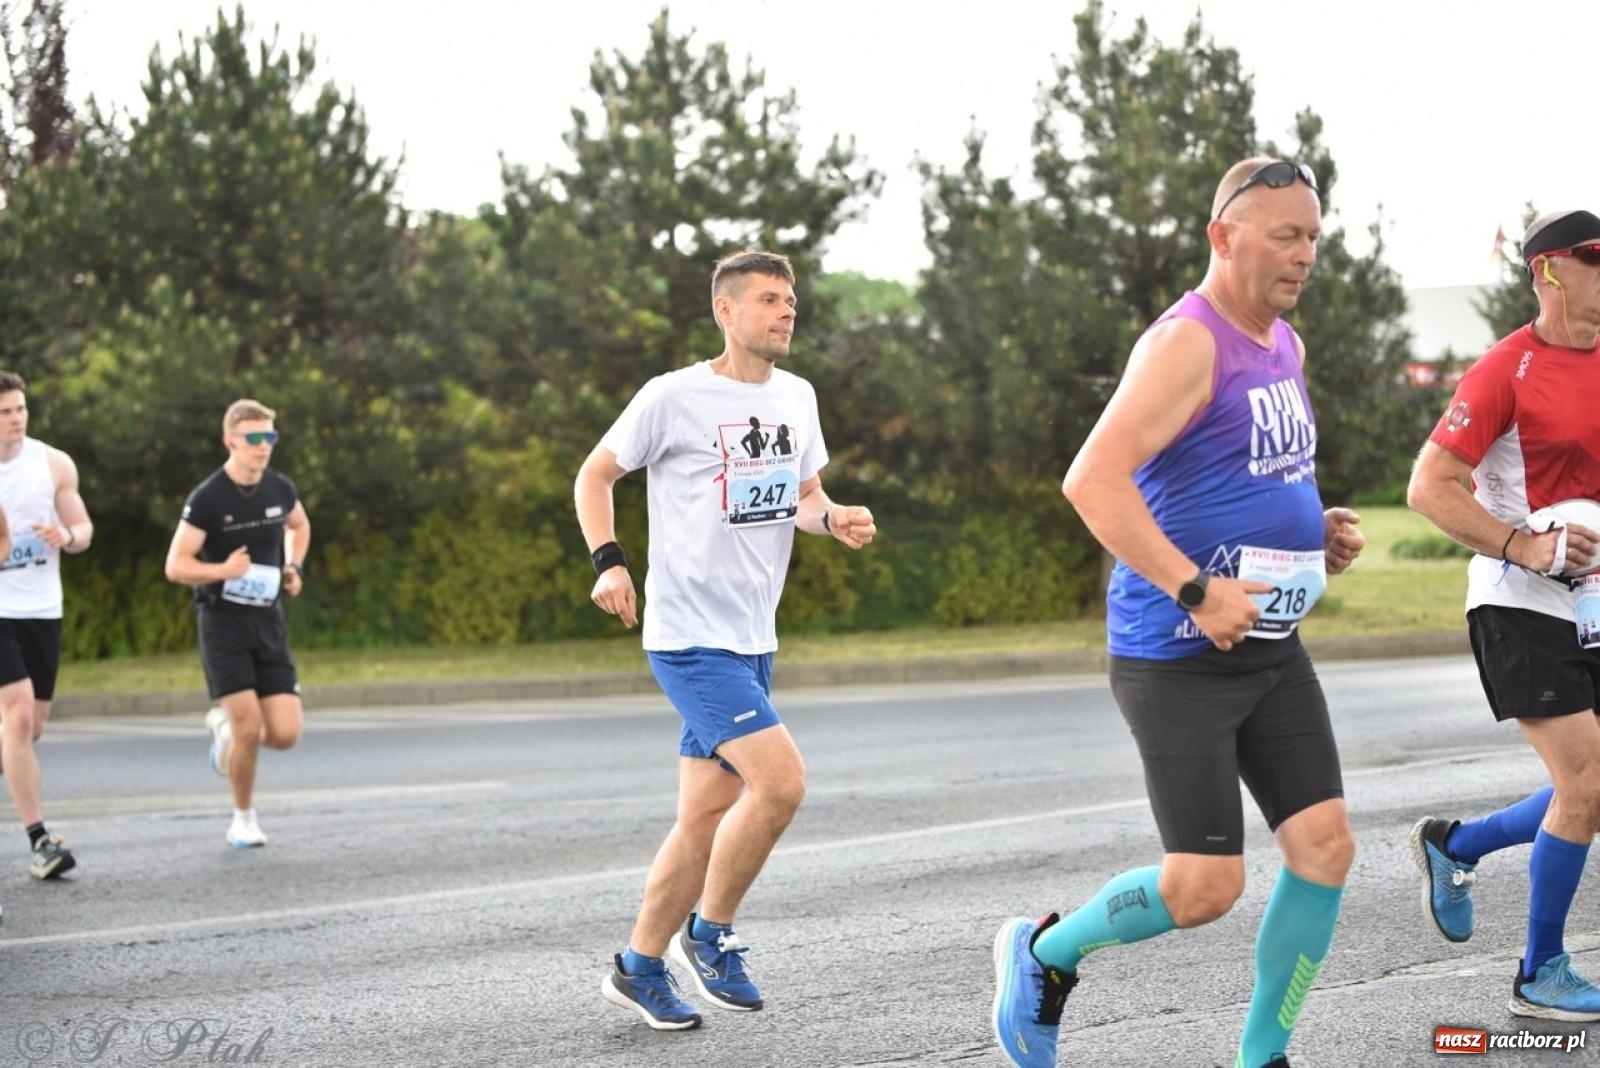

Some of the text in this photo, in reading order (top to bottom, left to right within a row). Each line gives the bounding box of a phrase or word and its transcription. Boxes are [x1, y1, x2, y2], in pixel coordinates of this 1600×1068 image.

[749, 483, 787, 508] 247
[1272, 552, 1291, 562] BIEG
[1264, 587, 1306, 614] 218
